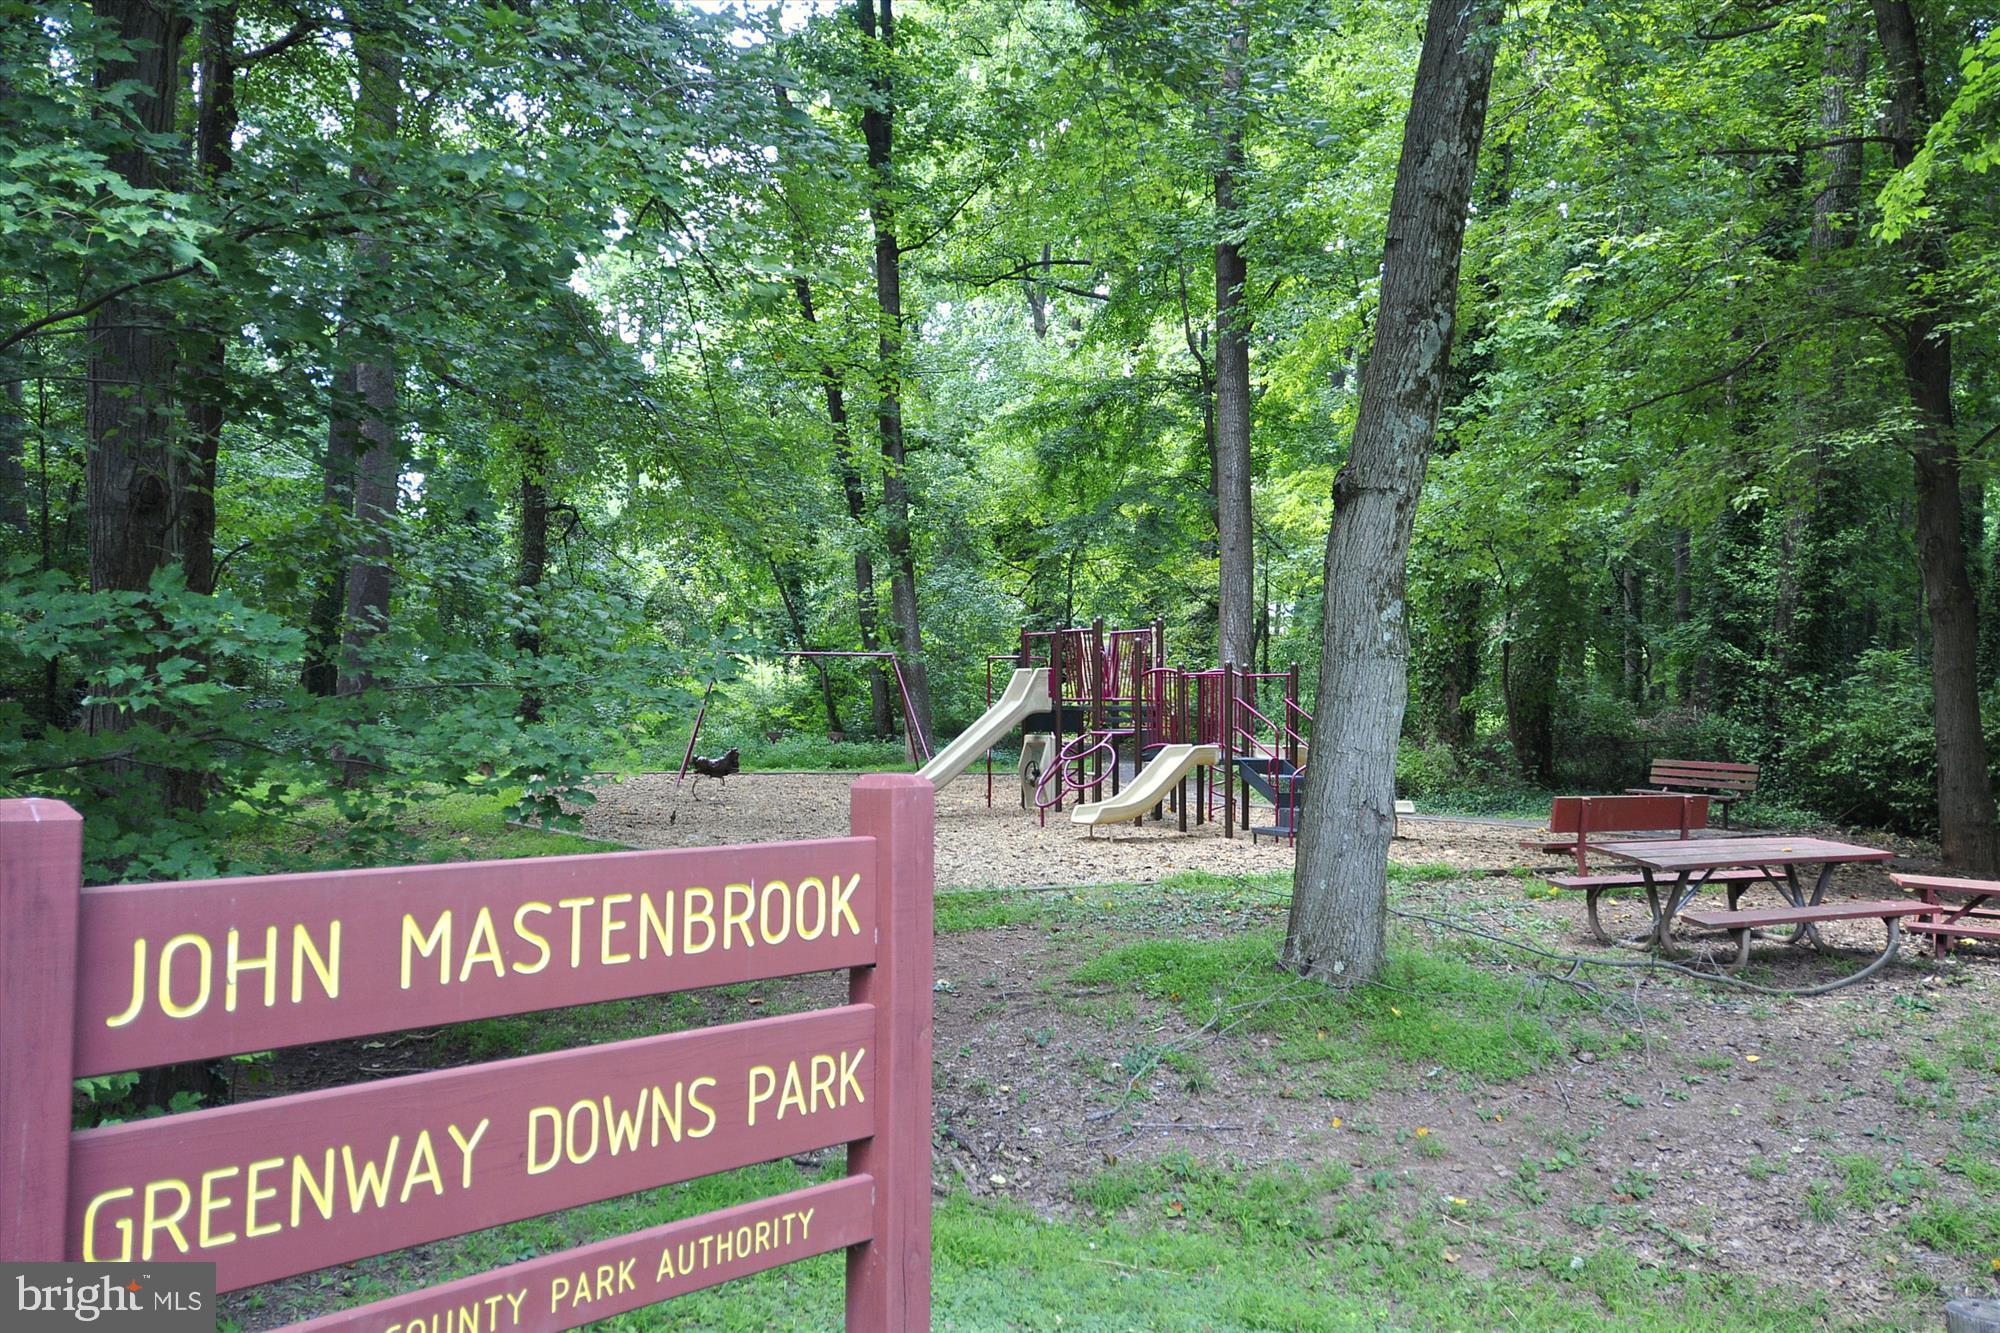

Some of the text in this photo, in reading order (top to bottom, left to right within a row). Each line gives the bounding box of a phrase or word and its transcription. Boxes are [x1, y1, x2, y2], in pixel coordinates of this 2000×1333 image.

[105, 872, 861, 1028] JOHN MASTENBROOK
[82, 1047, 865, 1262] GREENWAY DOWNS PARK
[384, 1207, 815, 1333] UNTY PARK AUTHORITY
